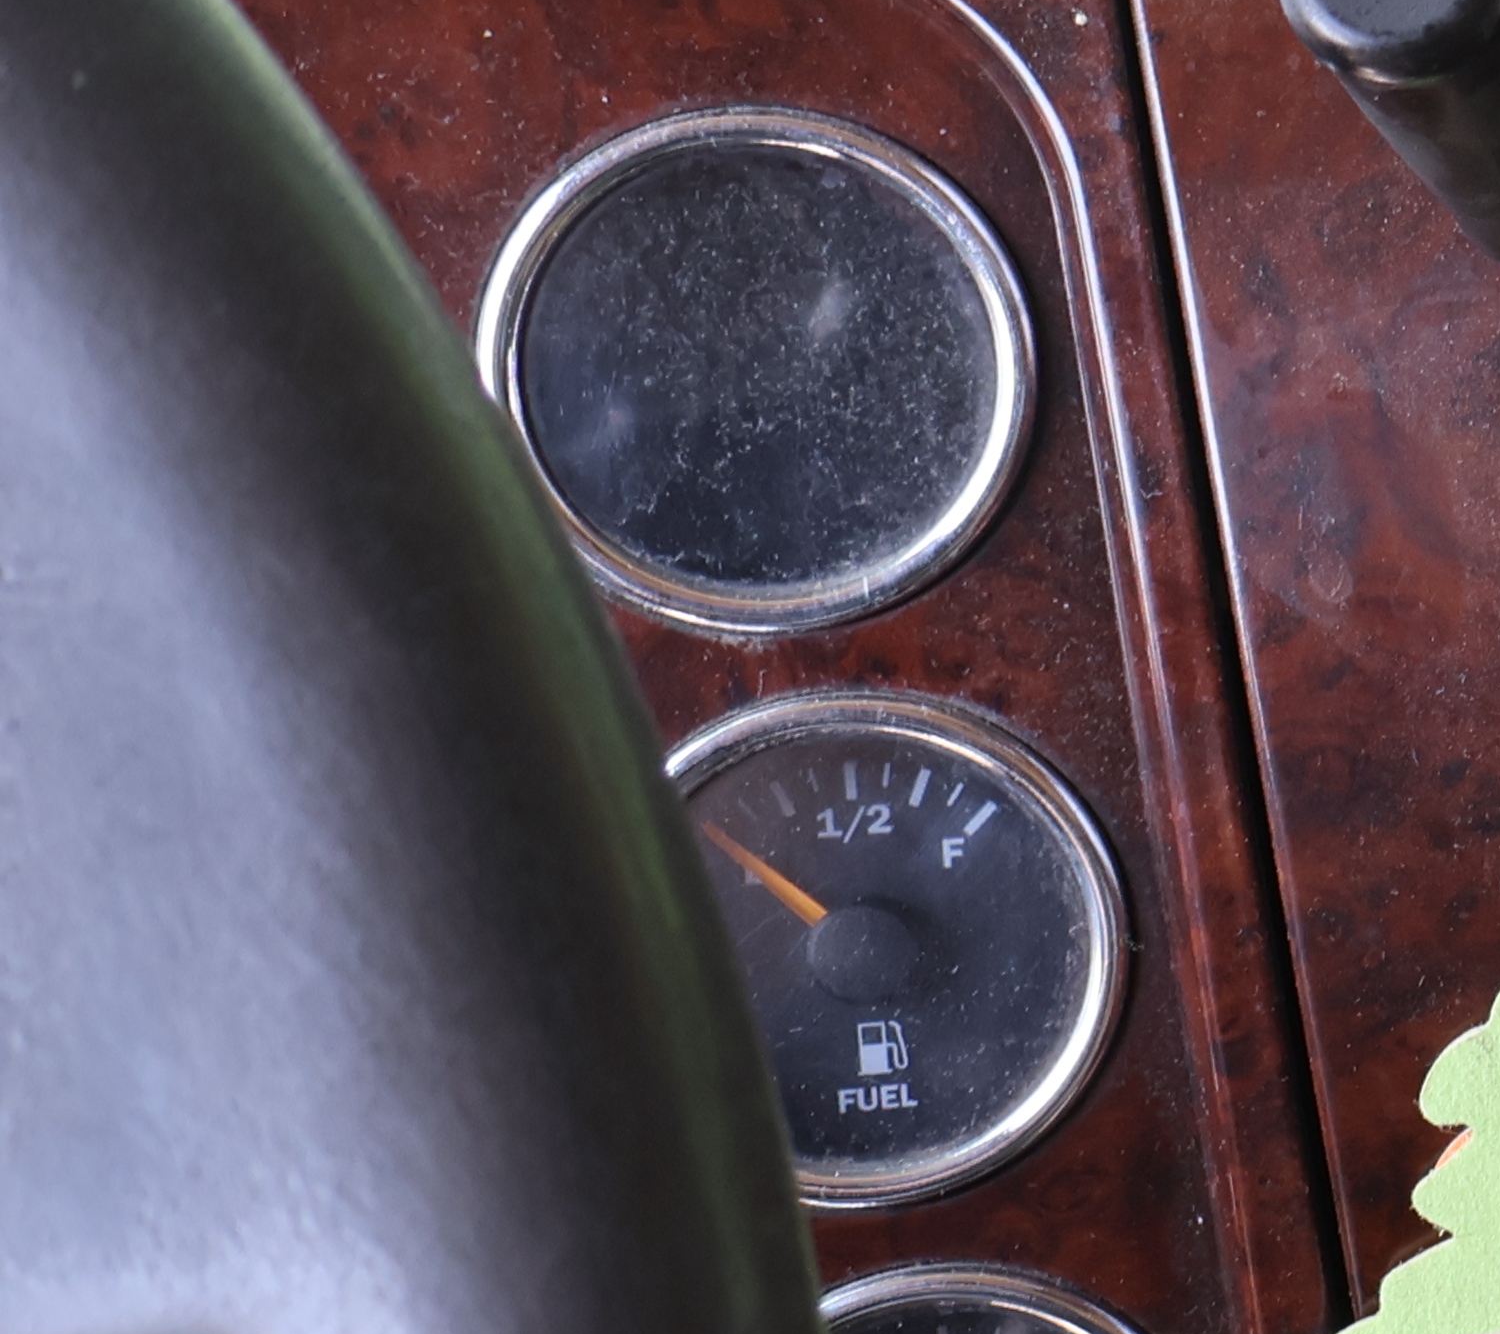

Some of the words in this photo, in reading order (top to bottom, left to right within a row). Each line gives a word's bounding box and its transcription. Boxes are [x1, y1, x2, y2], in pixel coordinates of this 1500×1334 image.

[816, 803, 894, 843] 1/2
[941, 837, 965, 868] F
[837, 1082, 919, 1114] FUEL
